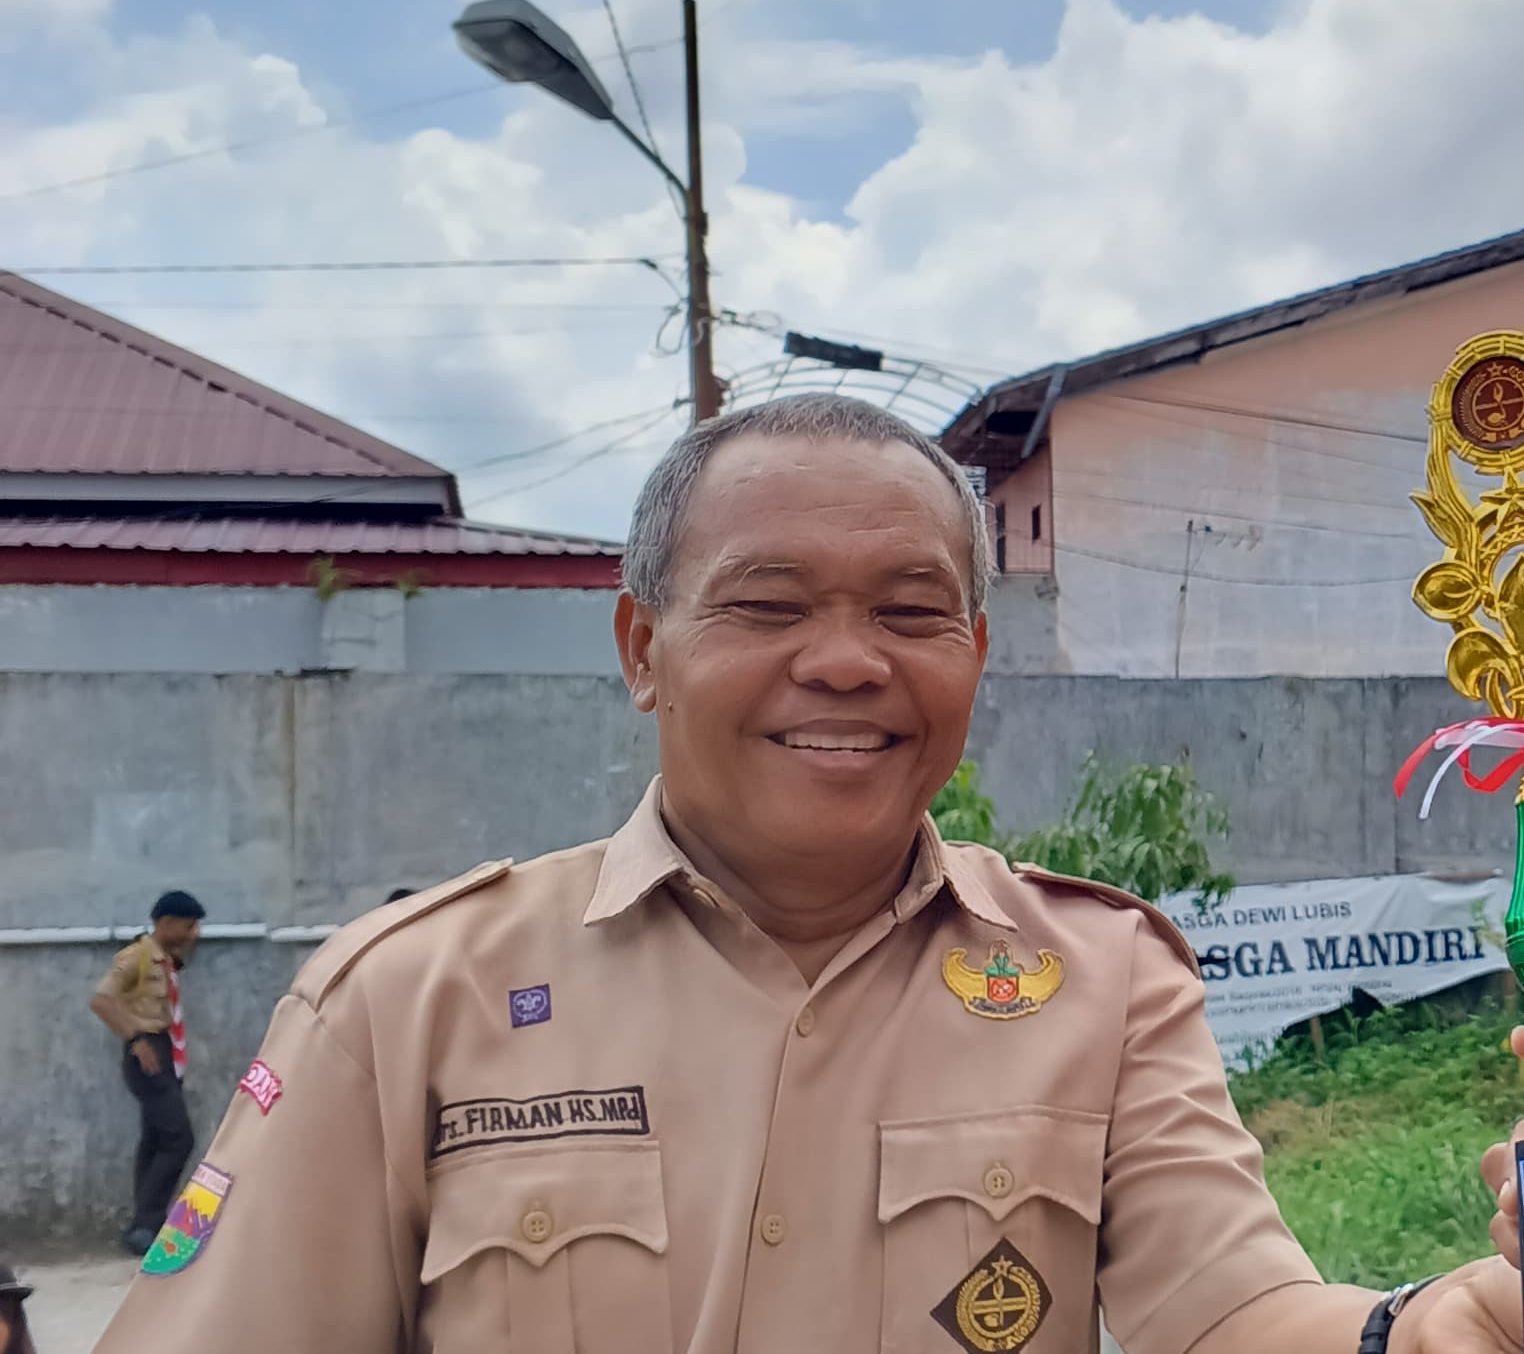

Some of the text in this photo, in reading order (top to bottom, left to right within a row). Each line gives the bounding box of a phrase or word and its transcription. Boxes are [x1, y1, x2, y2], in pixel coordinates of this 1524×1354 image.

[1233, 905, 1286, 926] DEWI
[1292, 901, 1352, 920] LUBIS
[1193, 926, 1485, 982] SGA MANDIRI
[465, 1101, 563, 1134] FIRMAN
